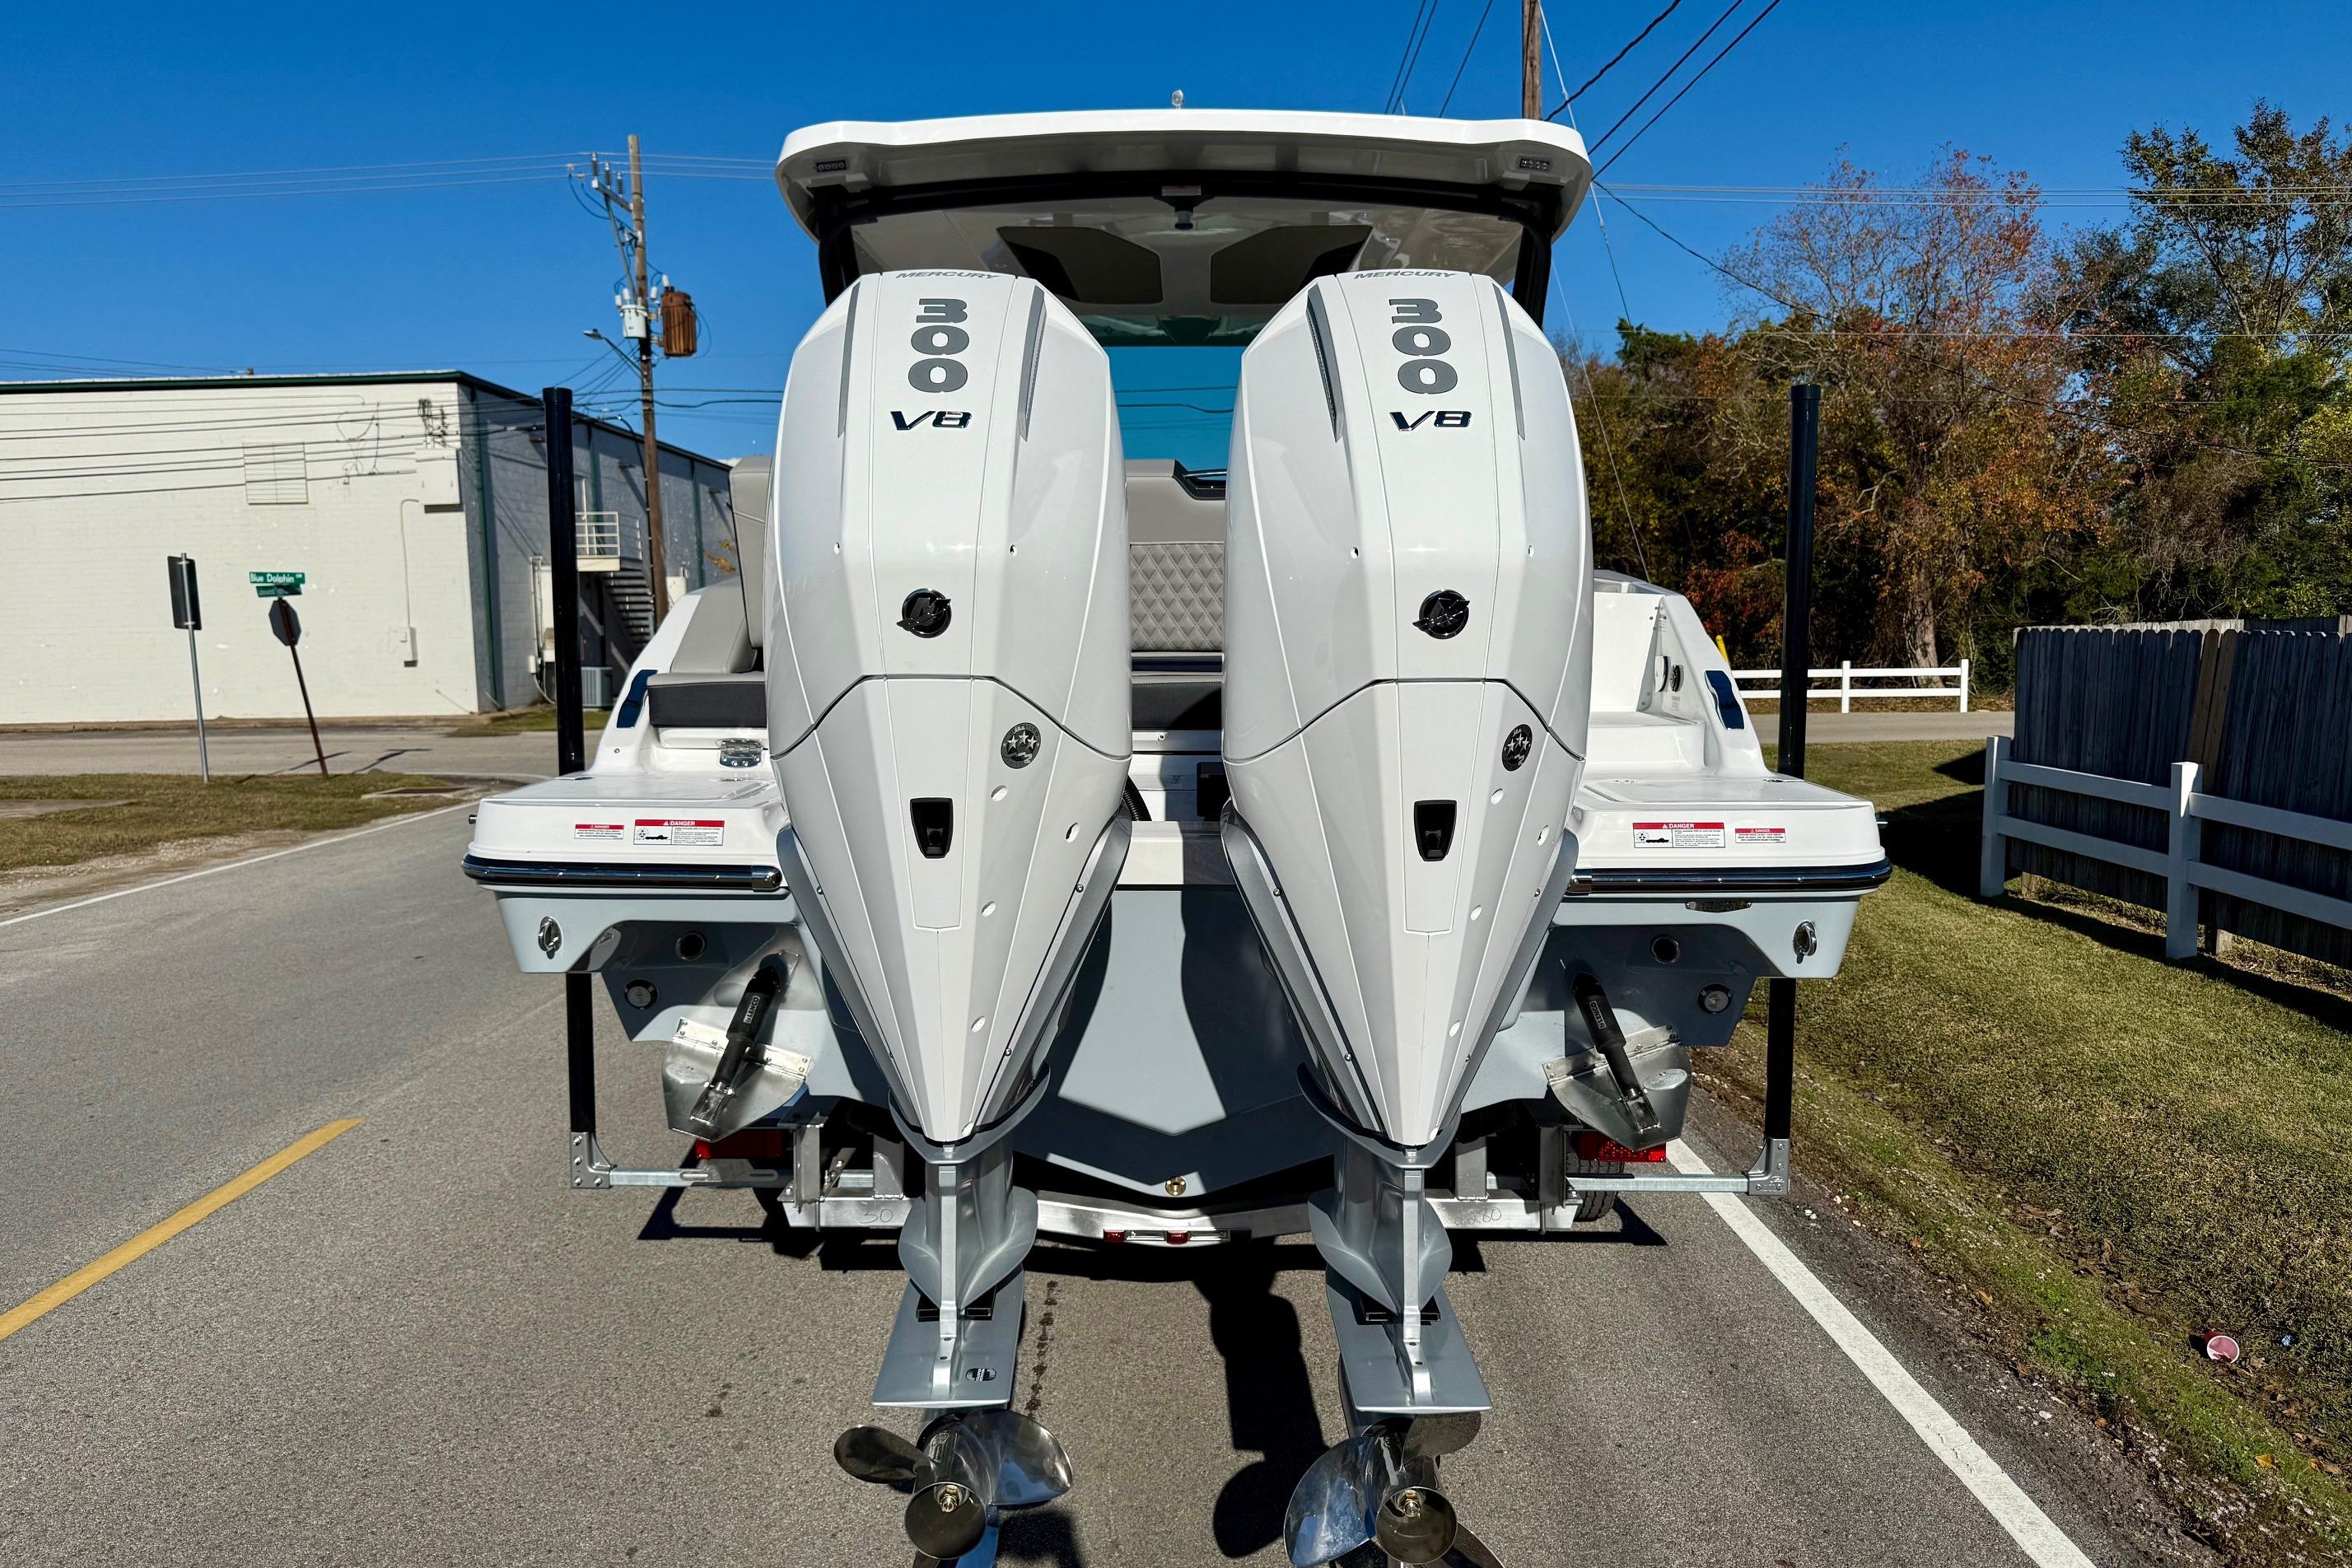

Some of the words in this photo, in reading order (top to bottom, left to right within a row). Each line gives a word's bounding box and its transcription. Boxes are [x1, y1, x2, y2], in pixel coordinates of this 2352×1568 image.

[896, 271, 1001, 279] MERCURY
[1354, 270, 1456, 279] MERCURY
[908, 298, 970, 393] 300
[1388, 298, 1458, 394] 300
[890, 411, 972, 431] V8
[1388, 411, 1472, 432] V8
[250, 572, 264, 582] Blue
[267, 573, 295, 584] Dolphin
[746, 996, 759, 1018] LENCO
